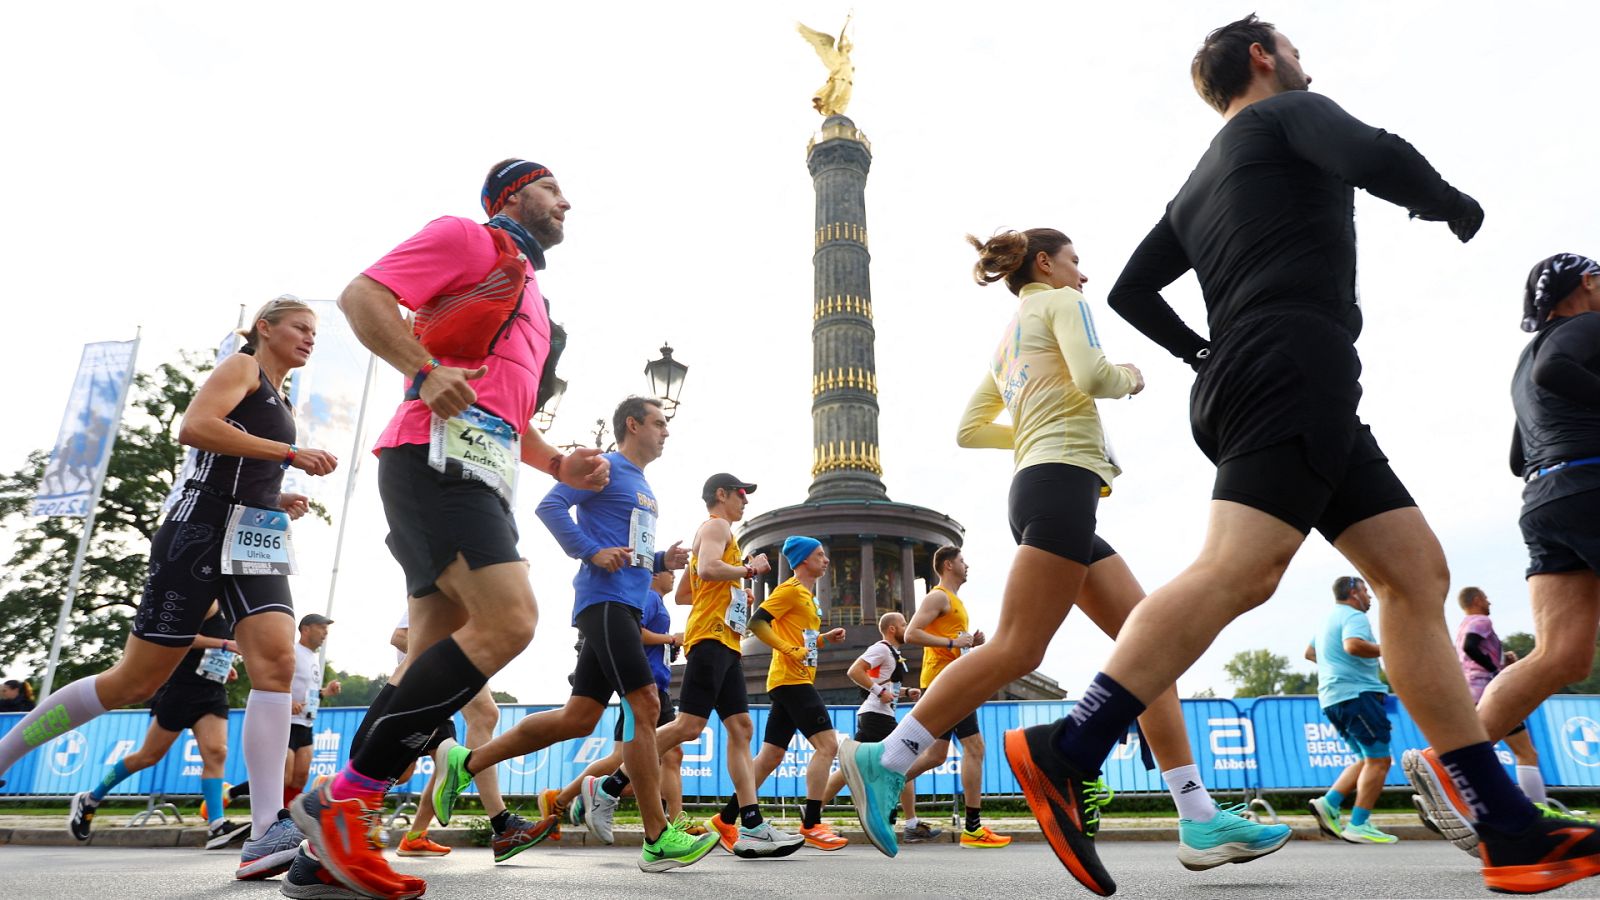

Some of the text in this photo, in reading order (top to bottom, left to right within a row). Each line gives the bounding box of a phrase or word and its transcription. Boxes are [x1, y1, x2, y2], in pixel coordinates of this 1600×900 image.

[238, 530, 281, 550] 18966
[247, 550, 271, 560] Ulrike
[1304, 723, 1338, 741] BM
[1214, 759, 1257, 770] Abbott
[680, 766, 712, 776] bbott
